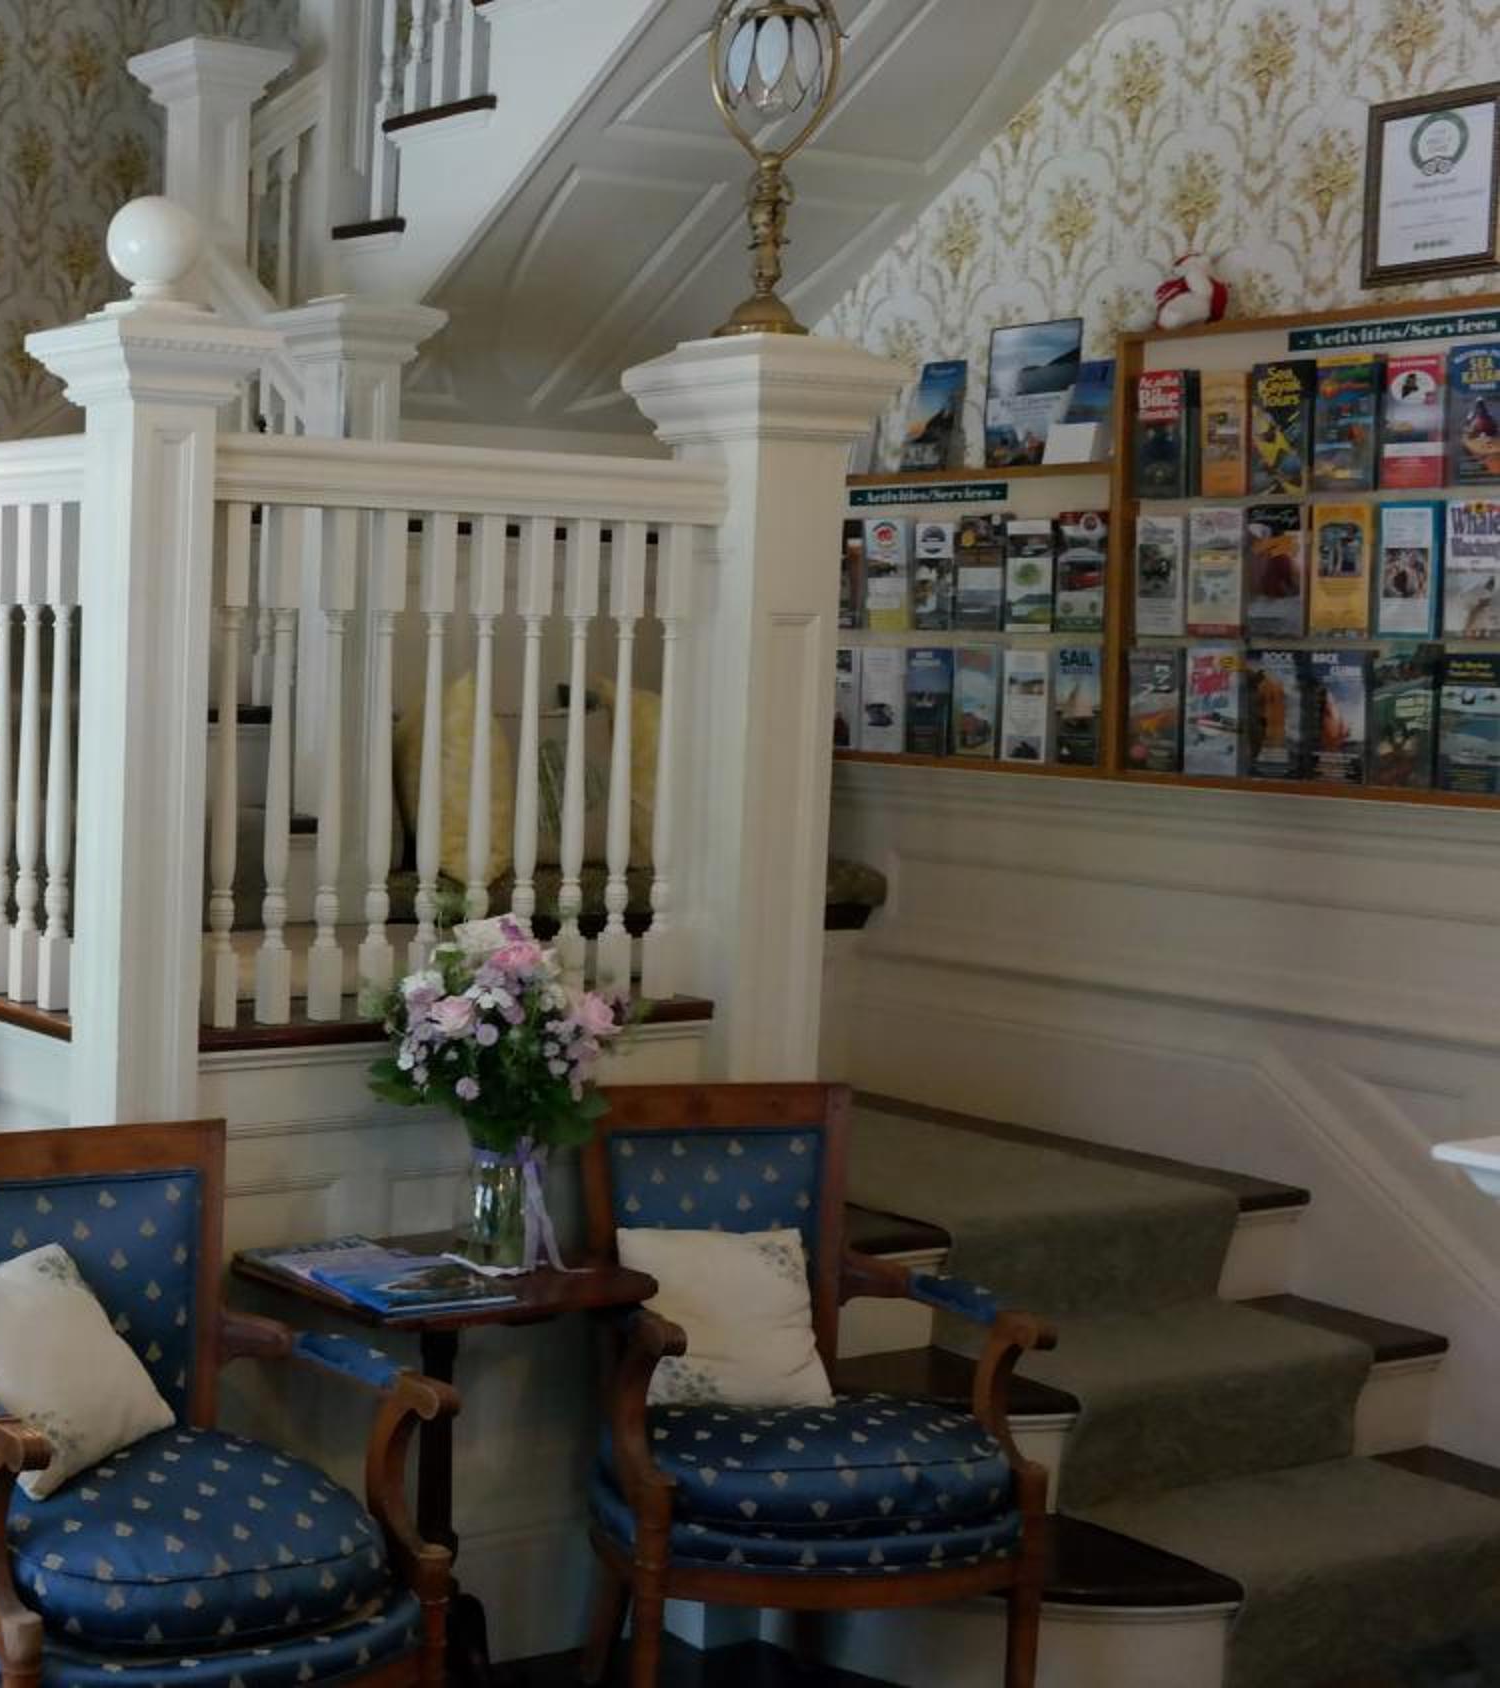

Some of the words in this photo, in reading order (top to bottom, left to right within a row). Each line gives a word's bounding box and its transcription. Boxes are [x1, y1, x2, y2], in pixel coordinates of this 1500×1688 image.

[1267, 367, 1295, 379] Sea
[1139, 388, 1181, 409] Bike
[1451, 507, 1500, 535] Whale
[1059, 650, 1093, 667] SAIL
